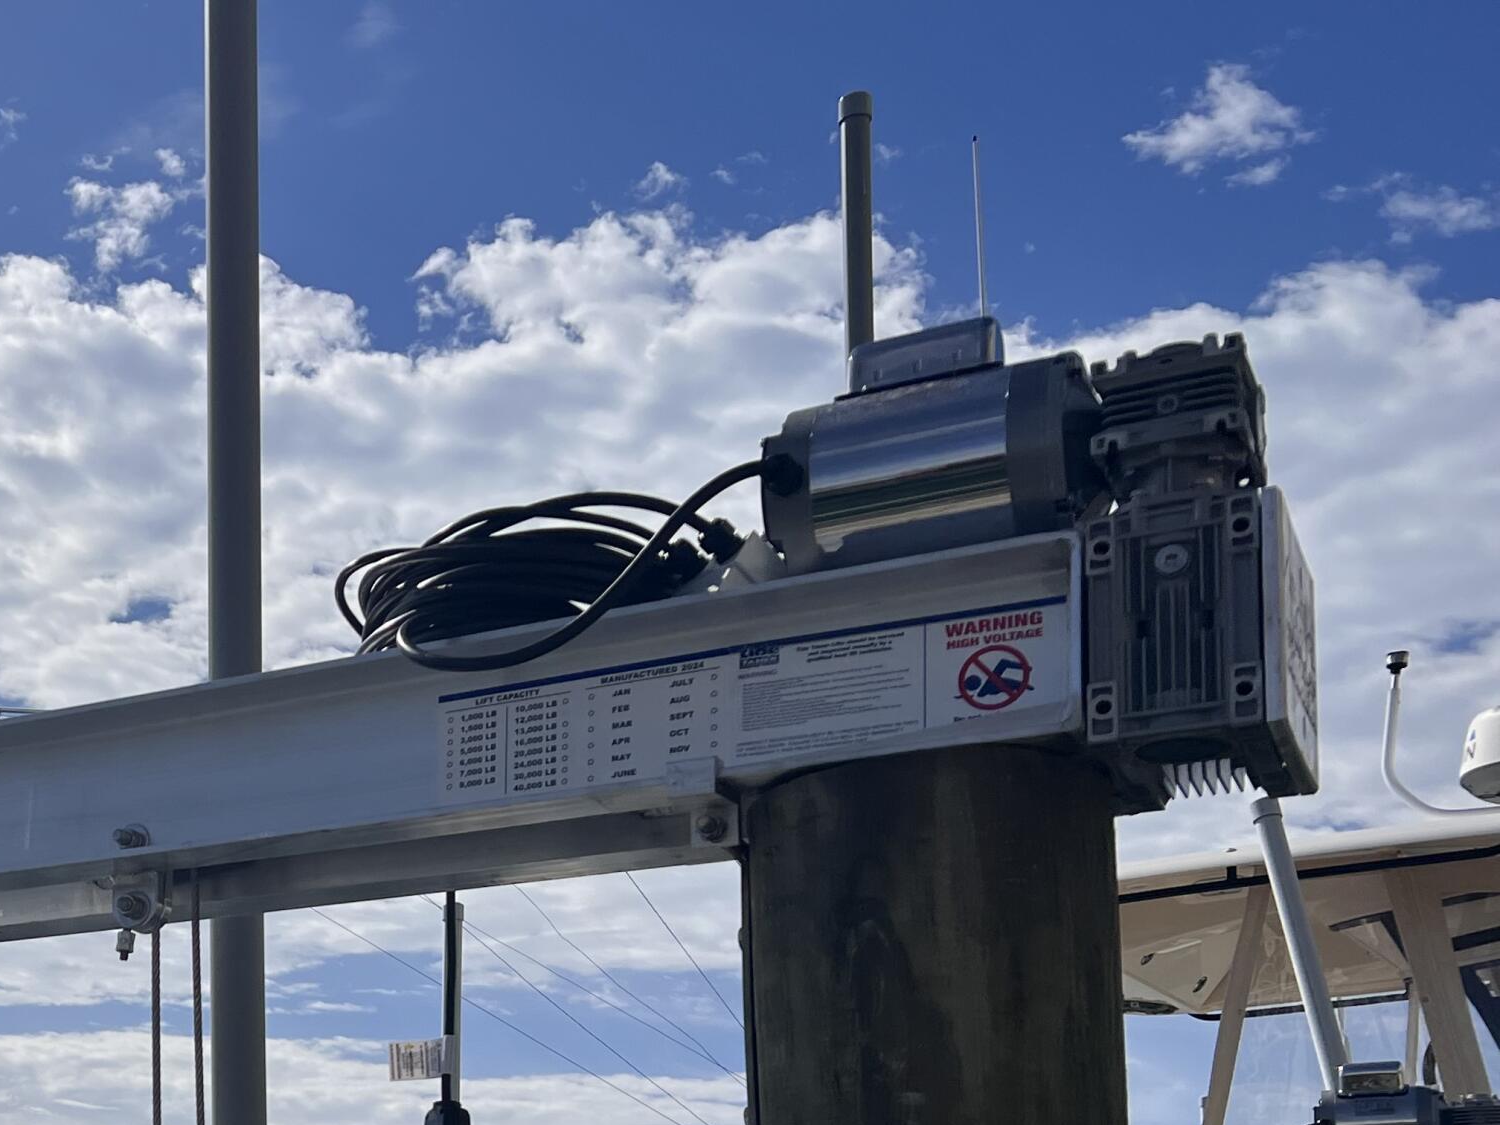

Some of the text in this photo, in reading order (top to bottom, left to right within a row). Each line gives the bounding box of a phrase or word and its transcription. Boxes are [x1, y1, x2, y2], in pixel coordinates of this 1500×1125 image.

[945, 611, 1043, 638] WARNING
[946, 627, 1043, 650] HIGH VOLTAGE
[600, 666, 678, 684] MANUFACTURED
[669, 678, 694, 688] JULY
[497, 689, 540, 701] CAPACITY
[612, 688, 631, 697] JAN
[546, 700, 558, 708] LB
[670, 695, 690, 704] AUG
[612, 704, 630, 713] FEB
[485, 710, 497, 718] LB
[546, 711, 557, 719] LB
[669, 711, 694, 721] SEPT
[485, 721, 497, 729] LB
[612, 720, 632, 730] MAR
[485, 732, 496, 740] LB
[669, 728, 689, 737] OCT
[545, 734, 557, 742] LB
[611, 737, 631, 746] APR
[485, 743, 496, 751] LB
[545, 745, 557, 753] LB
[669, 744, 690, 754] NOV
[485, 754, 496, 762] LB
[545, 756, 557, 764] LB
[611, 753, 631, 762] MAY
[484, 765, 496, 773] LB
[545, 768, 556, 776] LB
[611, 768, 637, 779] JUNE
[484, 776, 496, 785] LB
[544, 779, 557, 788] LB
